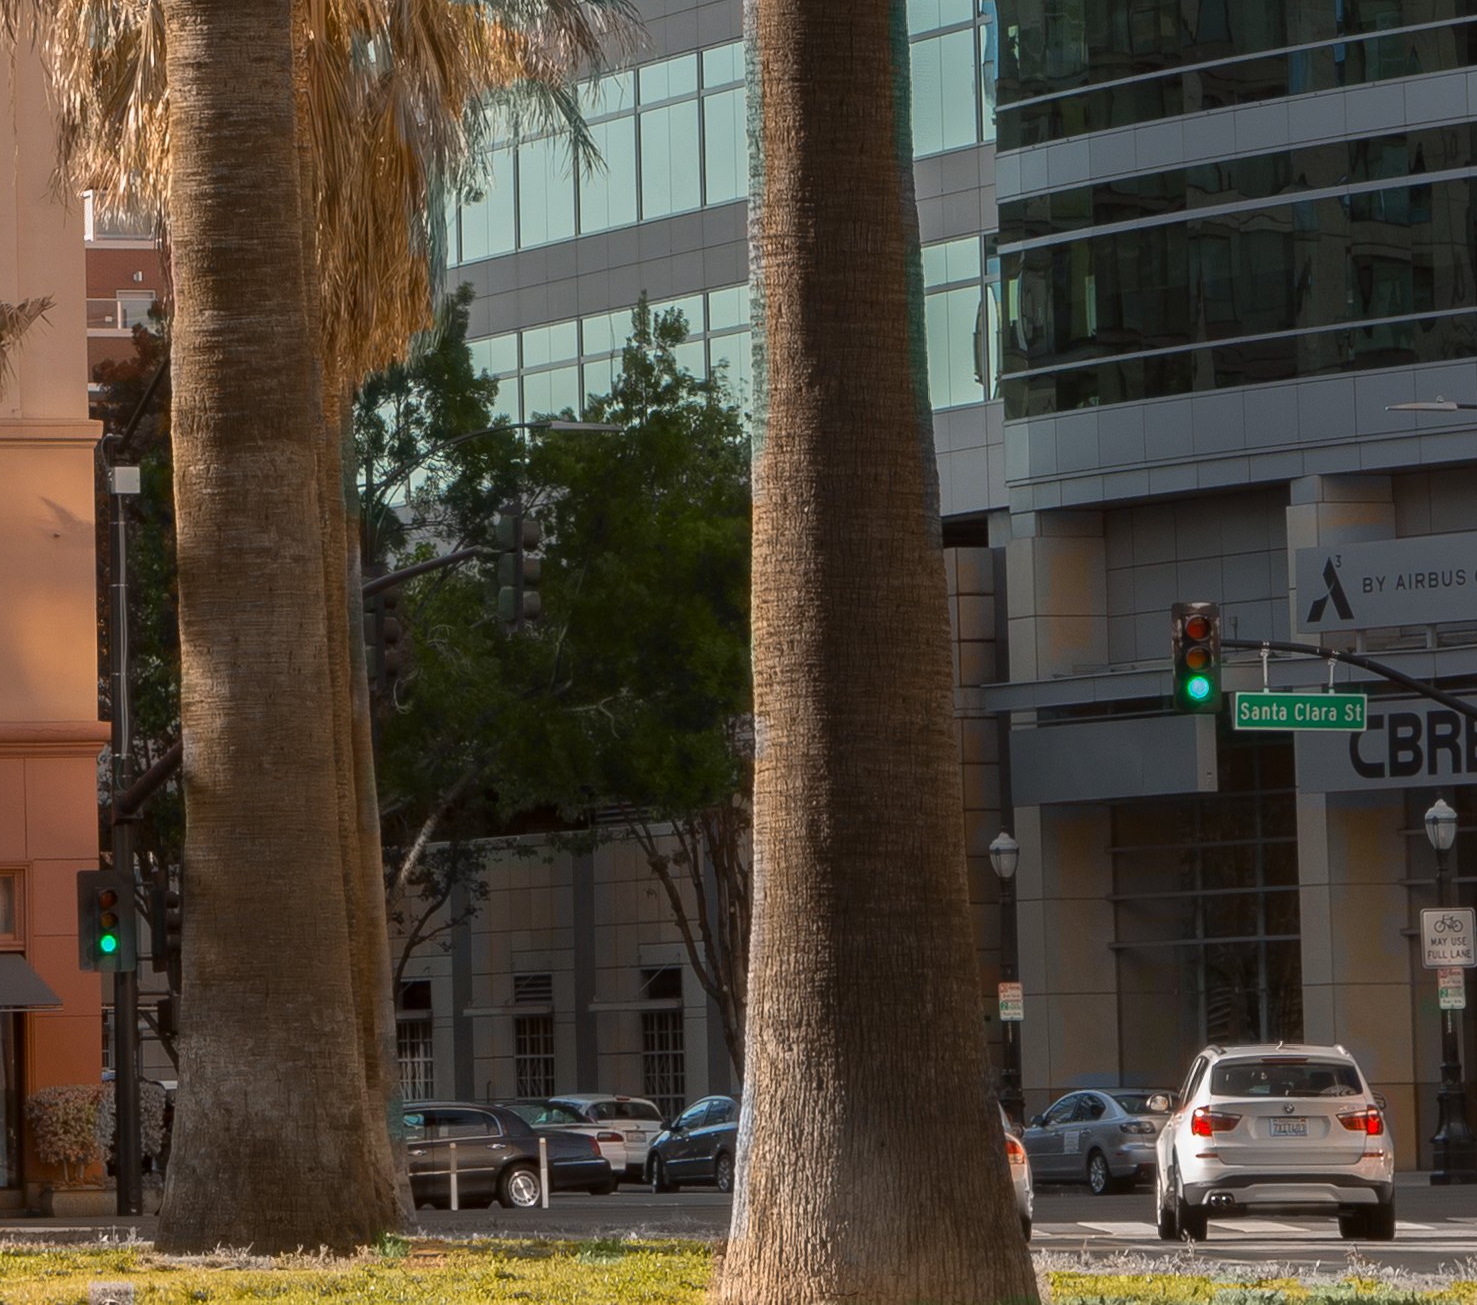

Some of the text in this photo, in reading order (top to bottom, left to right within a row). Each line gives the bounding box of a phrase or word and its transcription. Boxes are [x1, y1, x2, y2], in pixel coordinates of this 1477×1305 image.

[1362, 576, 1385, 593] BY
[1396, 569, 1467, 591] AIRBUS
[1239, 701, 1363, 722] Santa Clara St
[1430, 936, 1468, 947] MAY USE
[1427, 949, 1473, 960] FULL LANE
